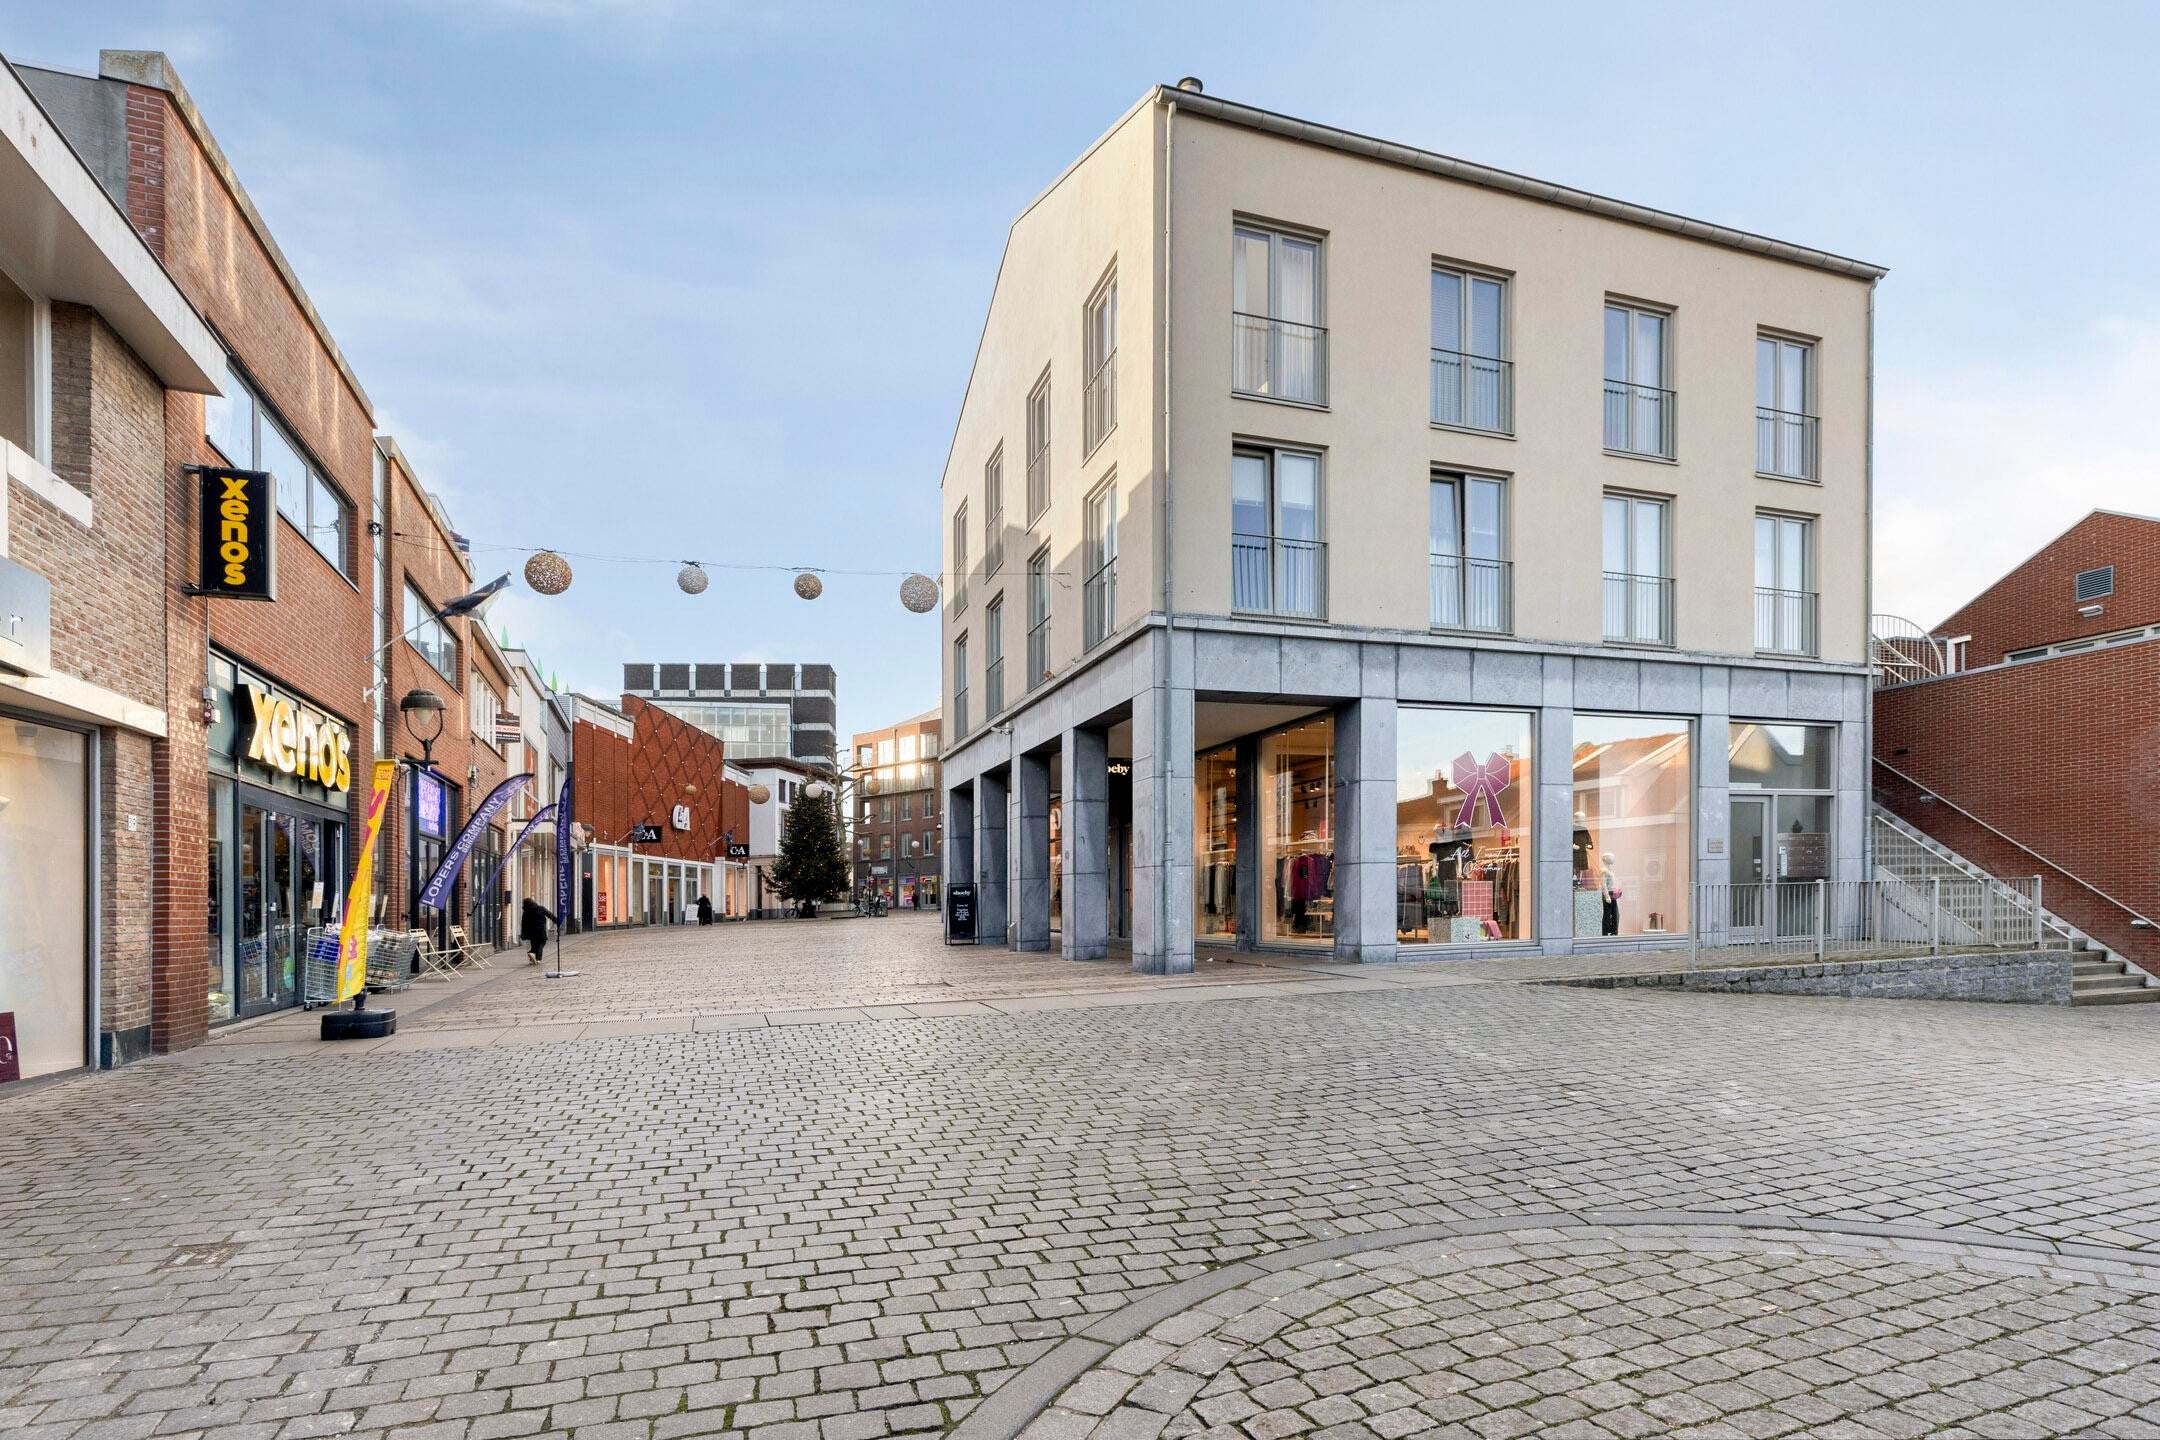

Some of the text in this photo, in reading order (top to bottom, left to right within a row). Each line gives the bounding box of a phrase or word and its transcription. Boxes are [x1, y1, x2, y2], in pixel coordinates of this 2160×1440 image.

[220, 477, 249, 585] xenos
[248, 684, 350, 793] xenos
[422, 851, 459, 906] LOPERS
[457, 797, 500, 851] COMPANY
[730, 846, 745, 857] C&A
